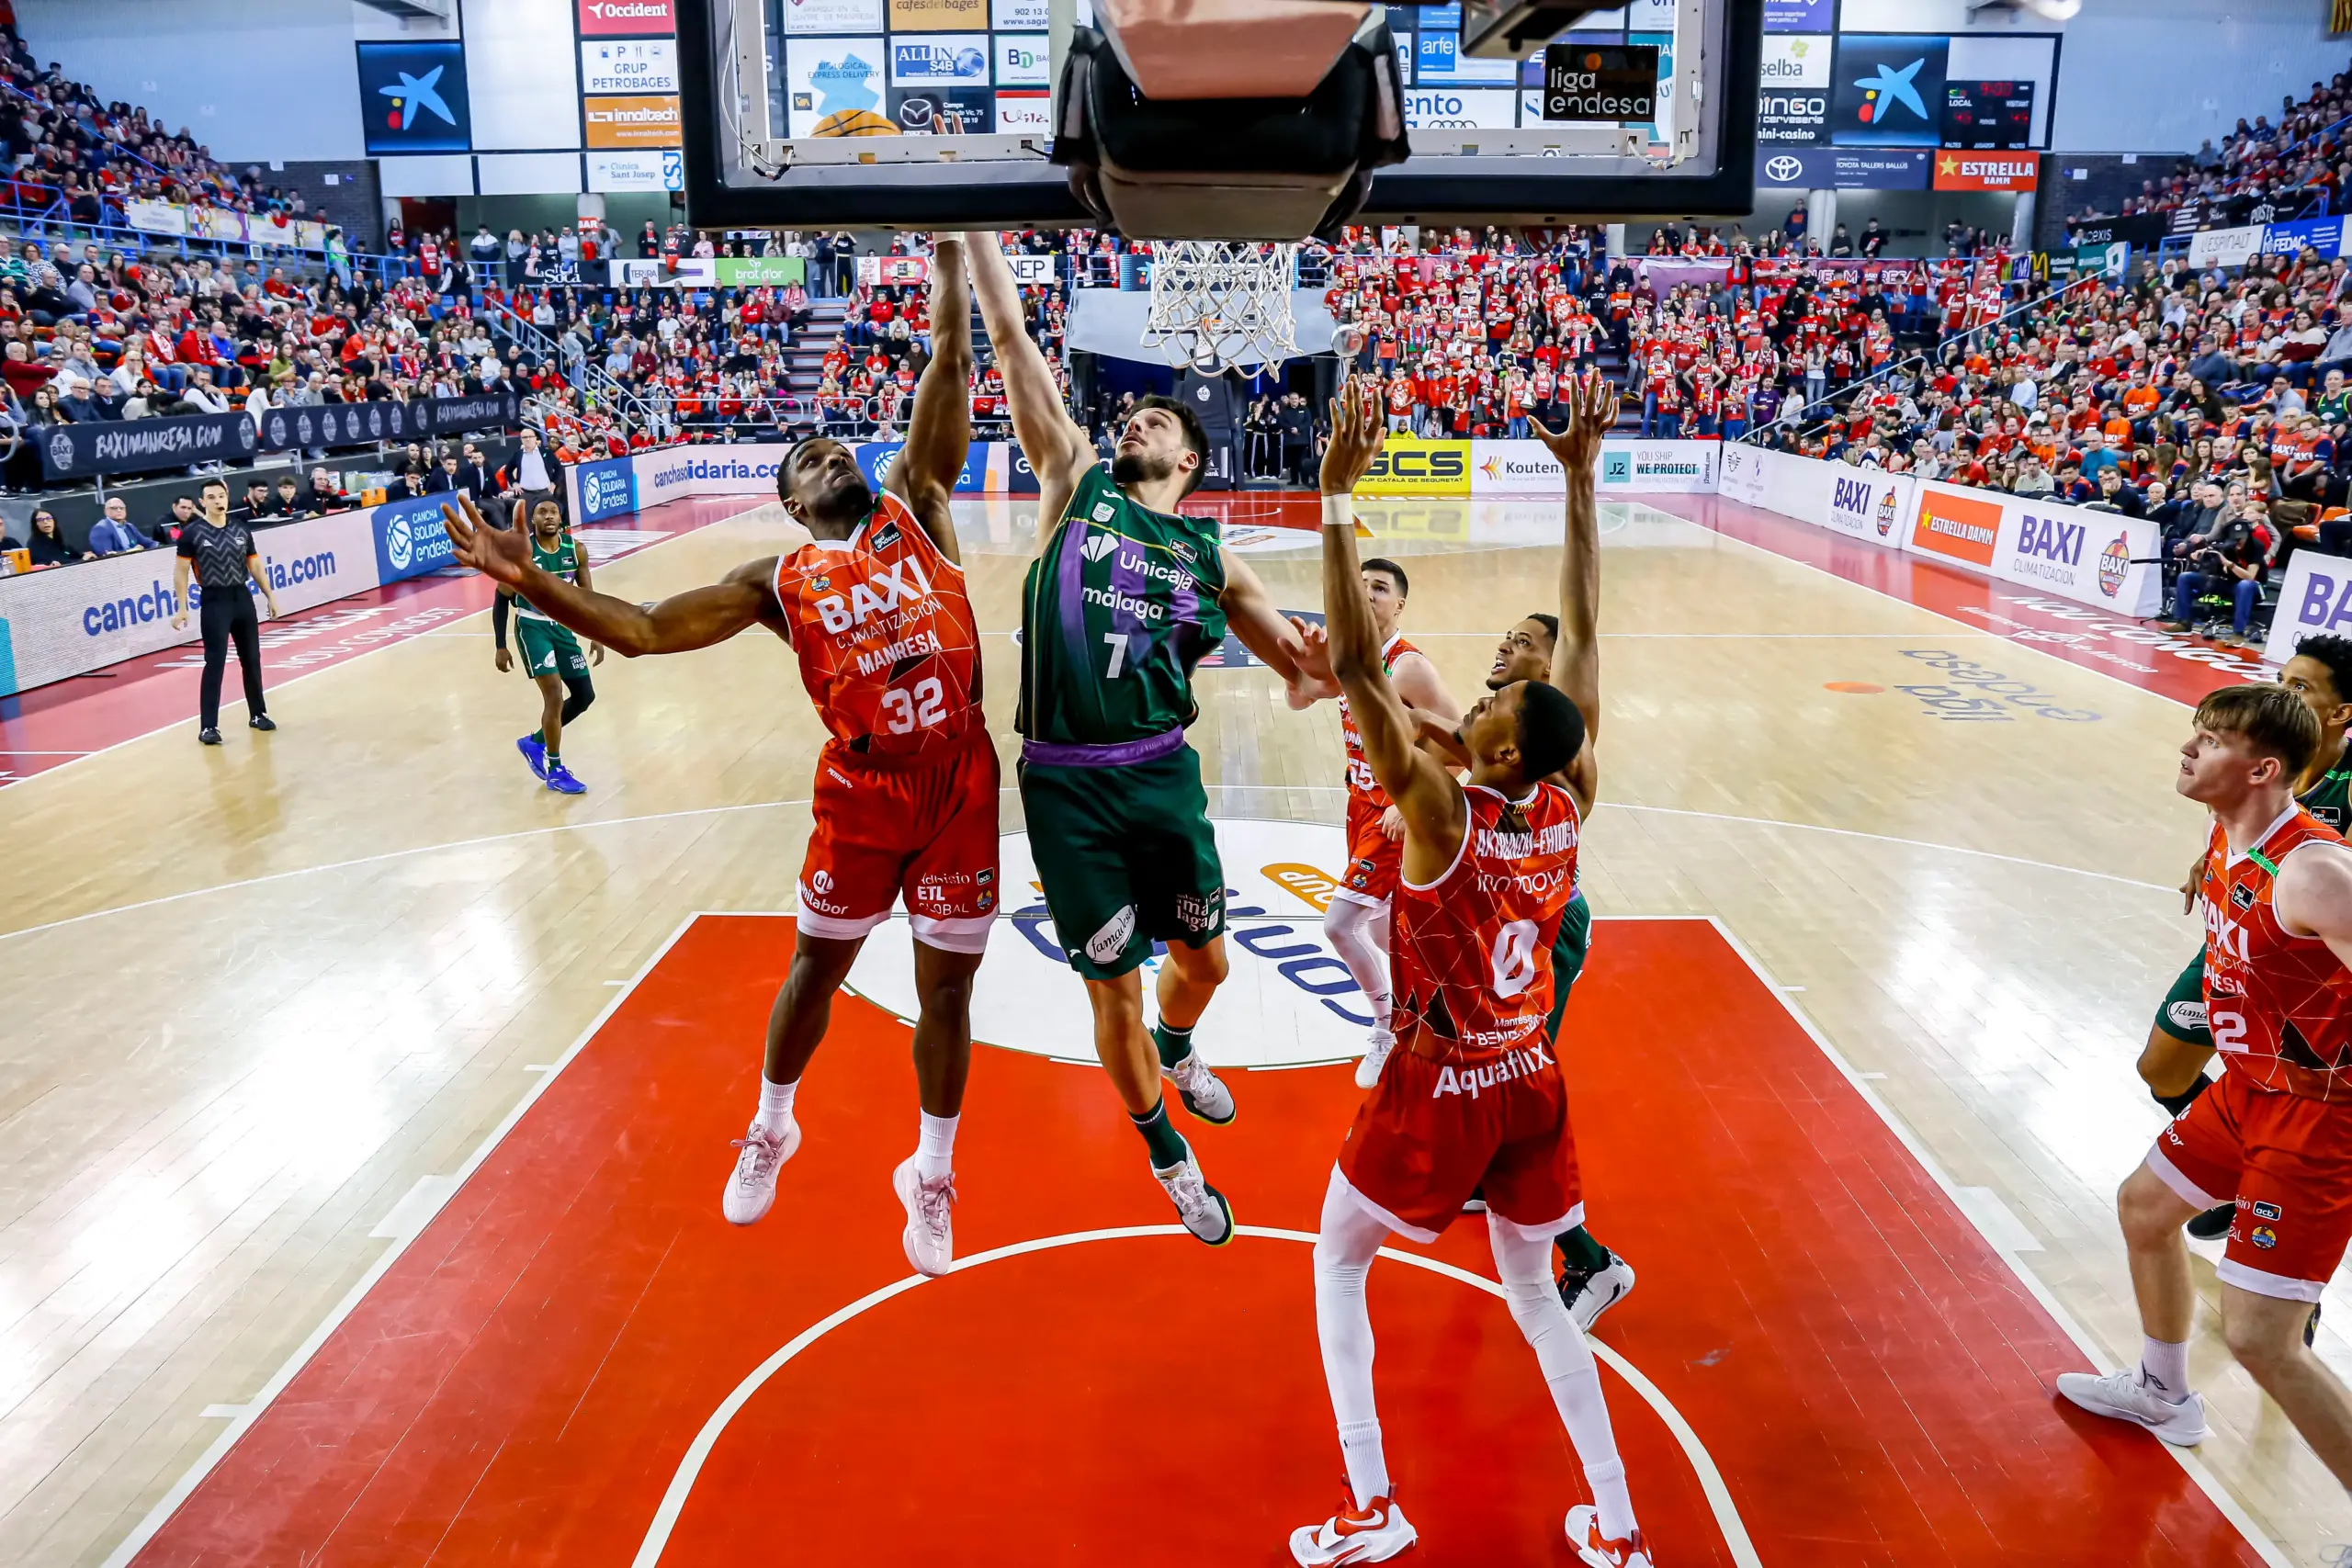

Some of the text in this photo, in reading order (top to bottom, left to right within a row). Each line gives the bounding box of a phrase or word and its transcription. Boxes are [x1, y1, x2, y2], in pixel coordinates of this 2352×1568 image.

[605, 3, 668, 17] Occident
[899, 47, 953, 62] ALL IN
[1421, 37, 1453, 54] arfe
[615, 63, 648, 73] GRUP
[843, 71, 880, 79] DELIVERY
[930, 61, 955, 72] S4B
[593, 77, 672, 88] PETROBAGES
[1550, 66, 1596, 93] liga
[1549, 92, 1650, 115] endesa
[1949, 99, 1973, 107] LOCAL
[1961, 162, 2034, 176] ESTRELLA
[1984, 176, 2011, 185] DAMM
[2273, 235, 2307, 253] FEDAC
[735, 268, 784, 279] brot d'or
[96, 424, 222, 458] BAXIMANRESA.COM
[1636, 451, 1673, 461] YOU SHIP
[1636, 463, 1698, 475] WE PROTECT
[601, 479, 627, 493] SOLIDARIA
[602, 491, 628, 510] endesa
[1833, 477, 1871, 516] BAXI
[413, 509, 439, 524] CANCHA
[414, 521, 447, 542] SOLIDAR
[1930, 516, 1994, 546] ESTRELLA DAMM
[2018, 514, 2086, 567] BAXI
[416, 538, 453, 562] endesa
[1119, 551, 1193, 592] Unicaja
[2101, 555, 2129, 577] BAXI
[814, 554, 933, 635] BAXI
[2298, 572, 2352, 630] BA
[856, 629, 943, 677] MANRESA
[1103, 632, 1129, 679] 7
[881, 676, 947, 735] 32
[917, 886, 945, 901] ETL
[1491, 919, 1539, 999] 0
[1494, 1013, 1532, 1027] Manresa
[2212, 1011, 2249, 1054] 2
[1432, 1042, 1556, 1100] Aquaflix
[2256, 1207, 2274, 1218] acb
